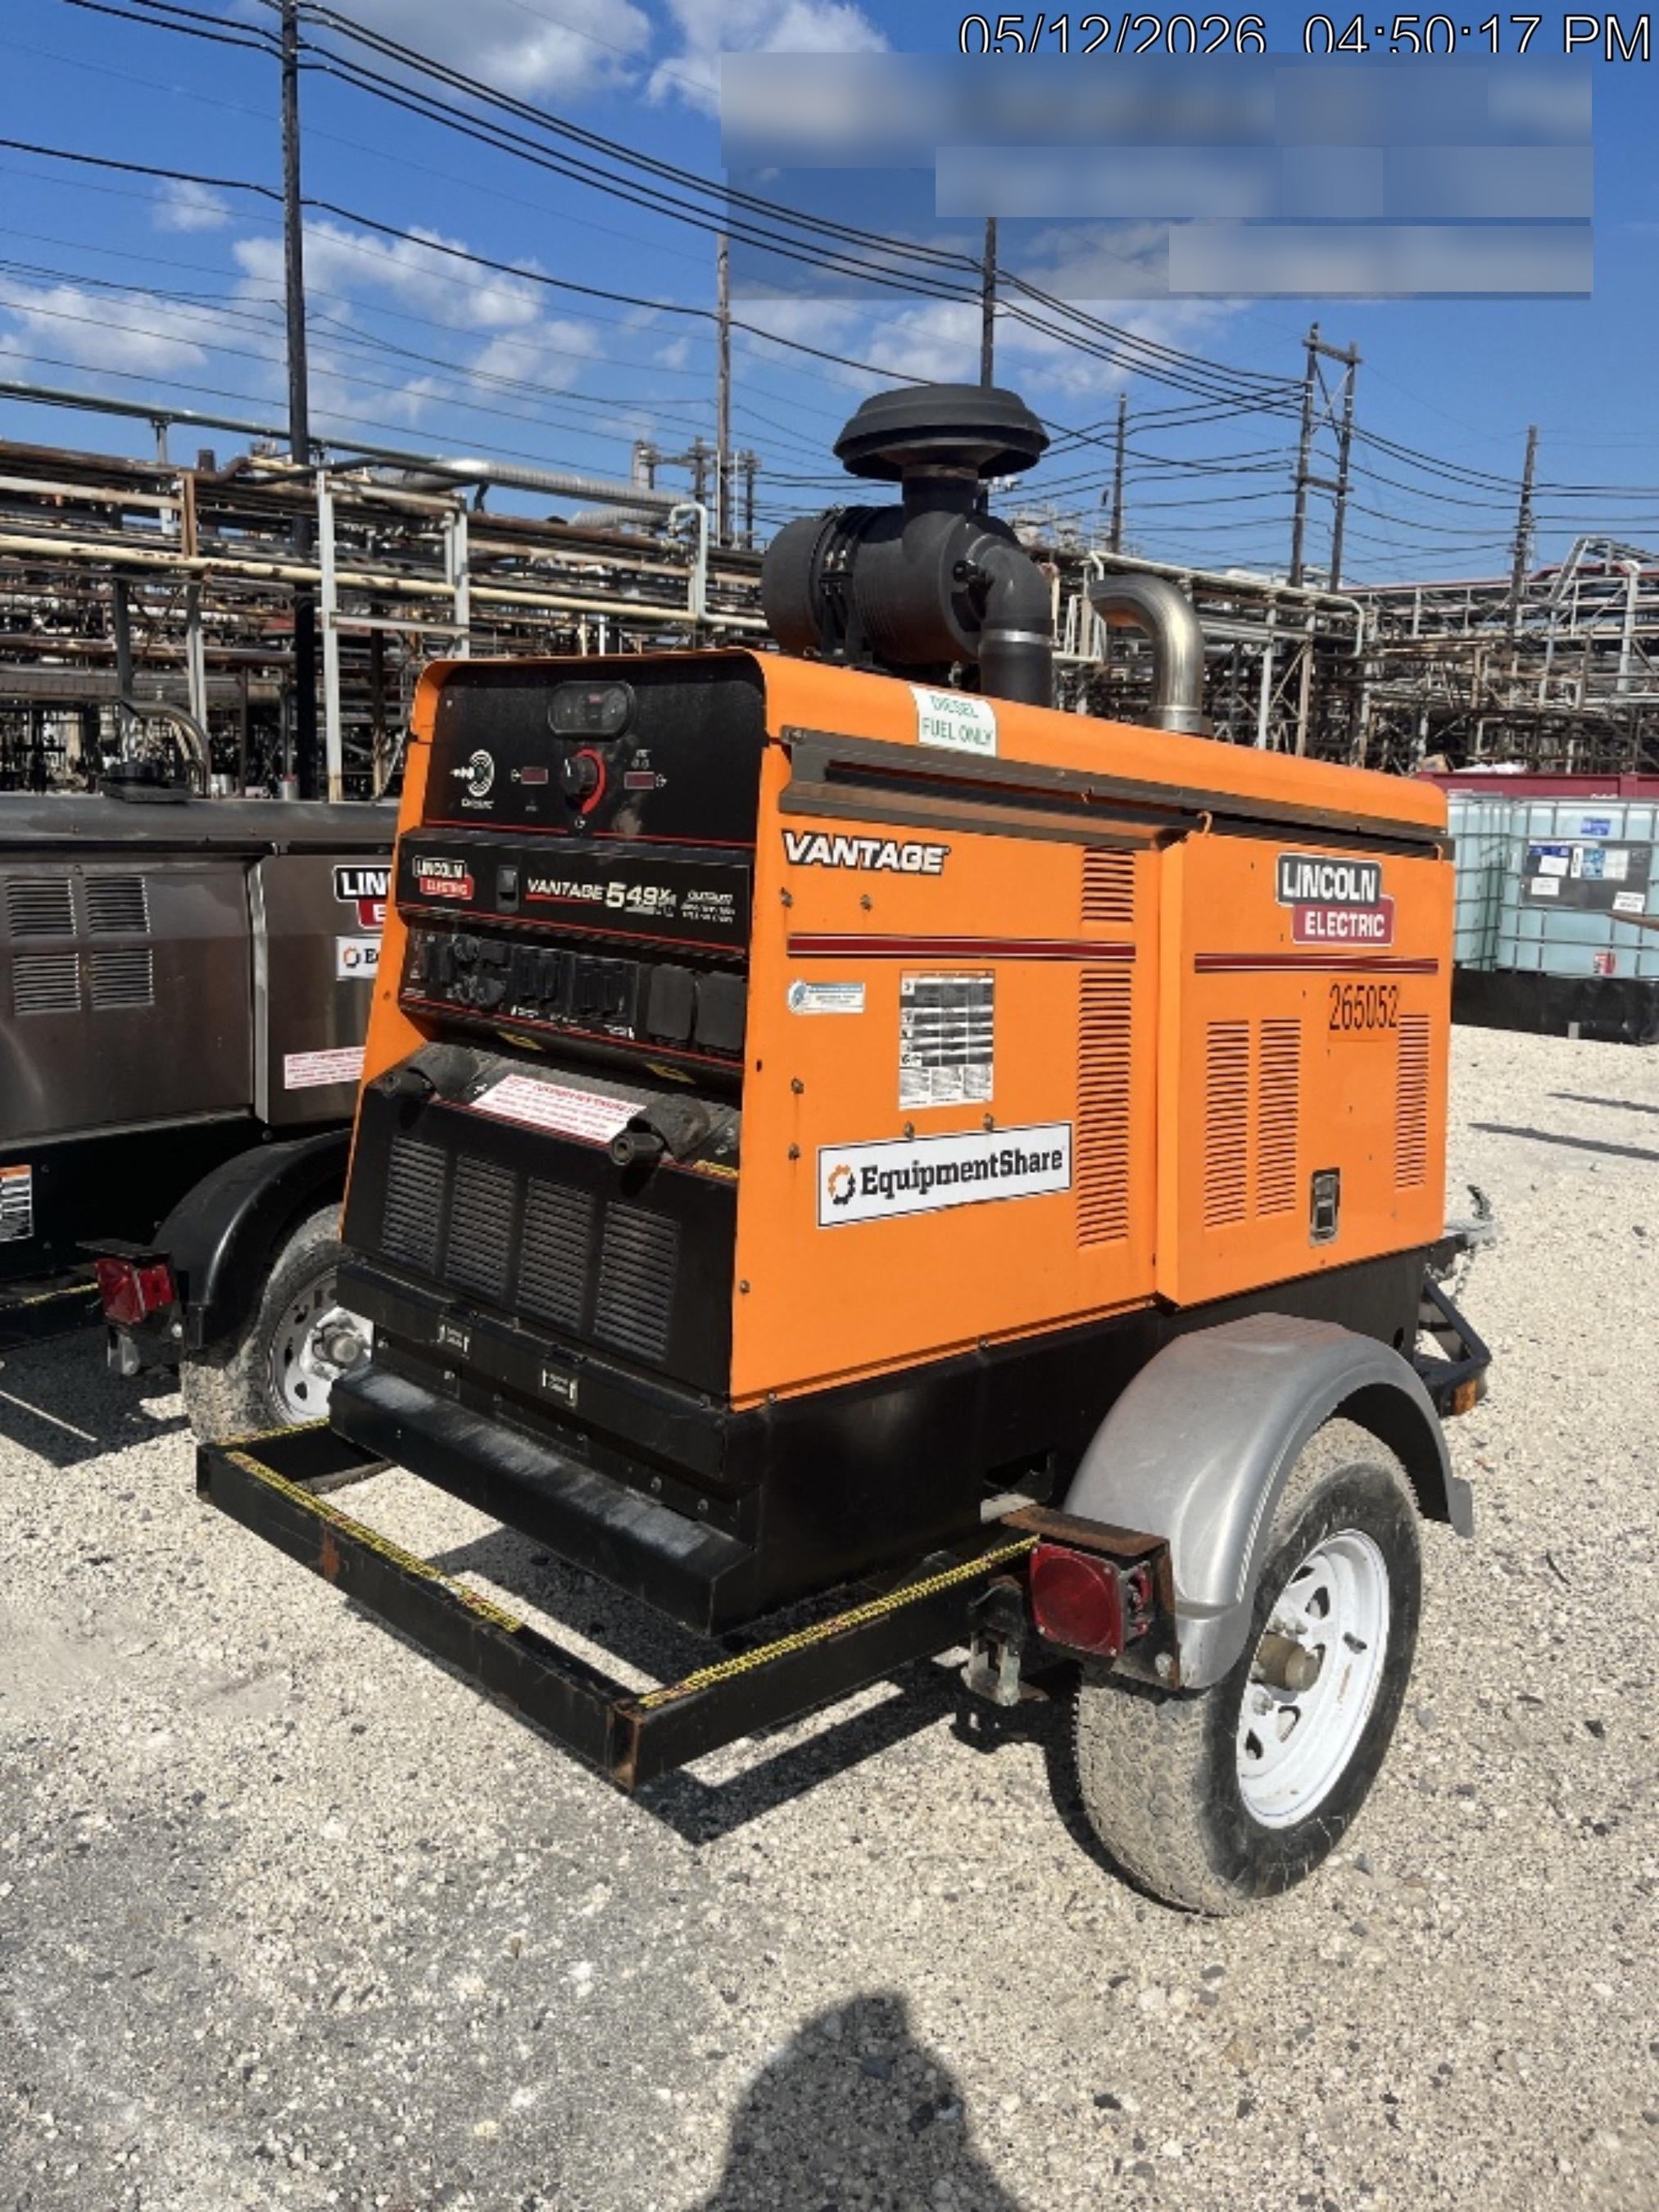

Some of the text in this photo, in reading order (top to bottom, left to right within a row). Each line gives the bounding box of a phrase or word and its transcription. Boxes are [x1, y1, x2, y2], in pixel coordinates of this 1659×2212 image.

[929, 695, 979, 718] DIESEL
[922, 717, 993, 746] FUEL ONLY
[782, 830, 946, 874] VANTAGE
[340, 872, 392, 895] LIN
[527, 877, 603, 900] VANTAGE
[1282, 862, 1376, 903] LINCOLN
[1304, 911, 1385, 937] ELECTRIC
[1329, 983, 1399, 1030] 265052
[859, 1148, 1064, 1199] EquipmentShare
